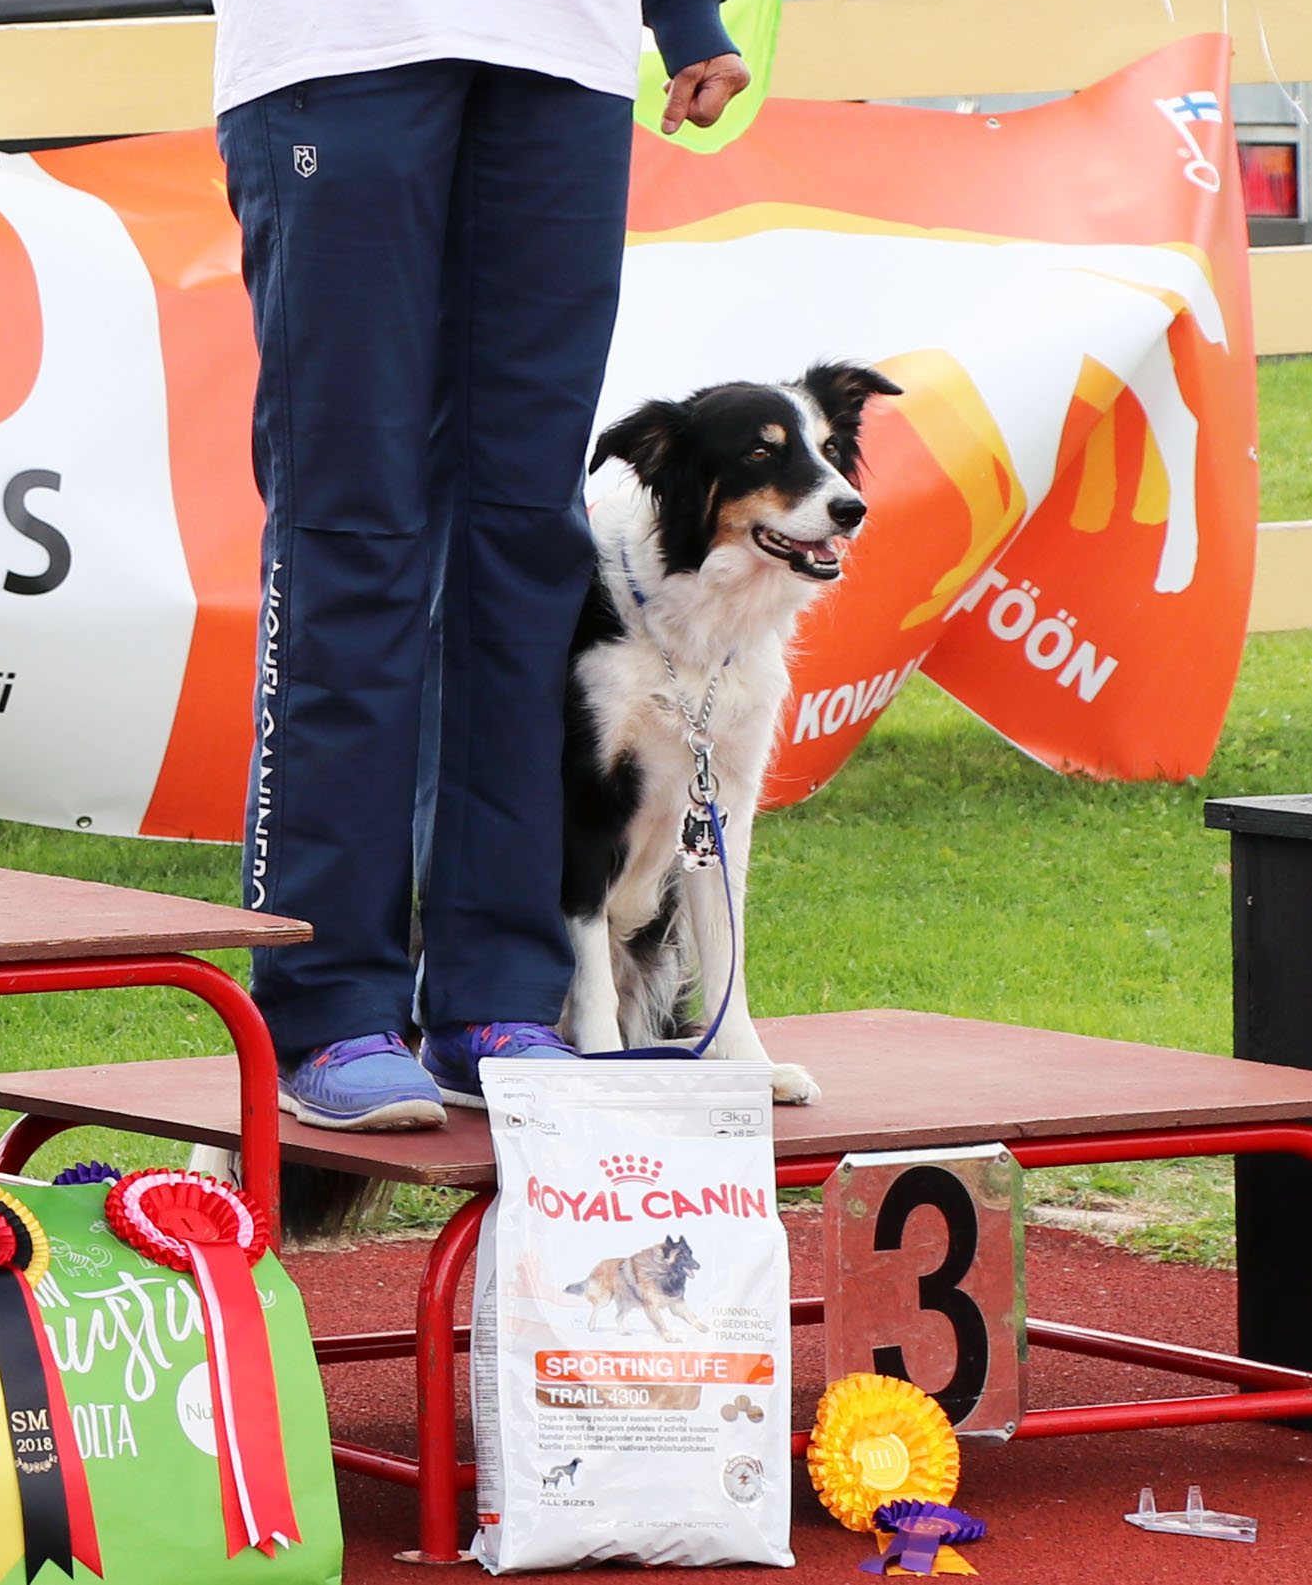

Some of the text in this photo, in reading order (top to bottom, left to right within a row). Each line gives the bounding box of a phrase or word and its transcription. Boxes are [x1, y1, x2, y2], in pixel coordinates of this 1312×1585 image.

[942, 566, 1119, 703] TÖÖN
[721, 1111, 751, 1123] 3kg
[528, 1176, 767, 1222] ROYAL CANIN
[872, 1165, 990, 1428] 3
[545, 1354, 728, 1378] SPORTING LIFE
[546, 1388, 650, 1405] TRAIL 4300
[11, 1409, 50, 1433] SM
[186, 1402, 213, 1422] Nu
[16, 1437, 54, 1453] 2018
[562, 1499, 595, 1507] SIZES
